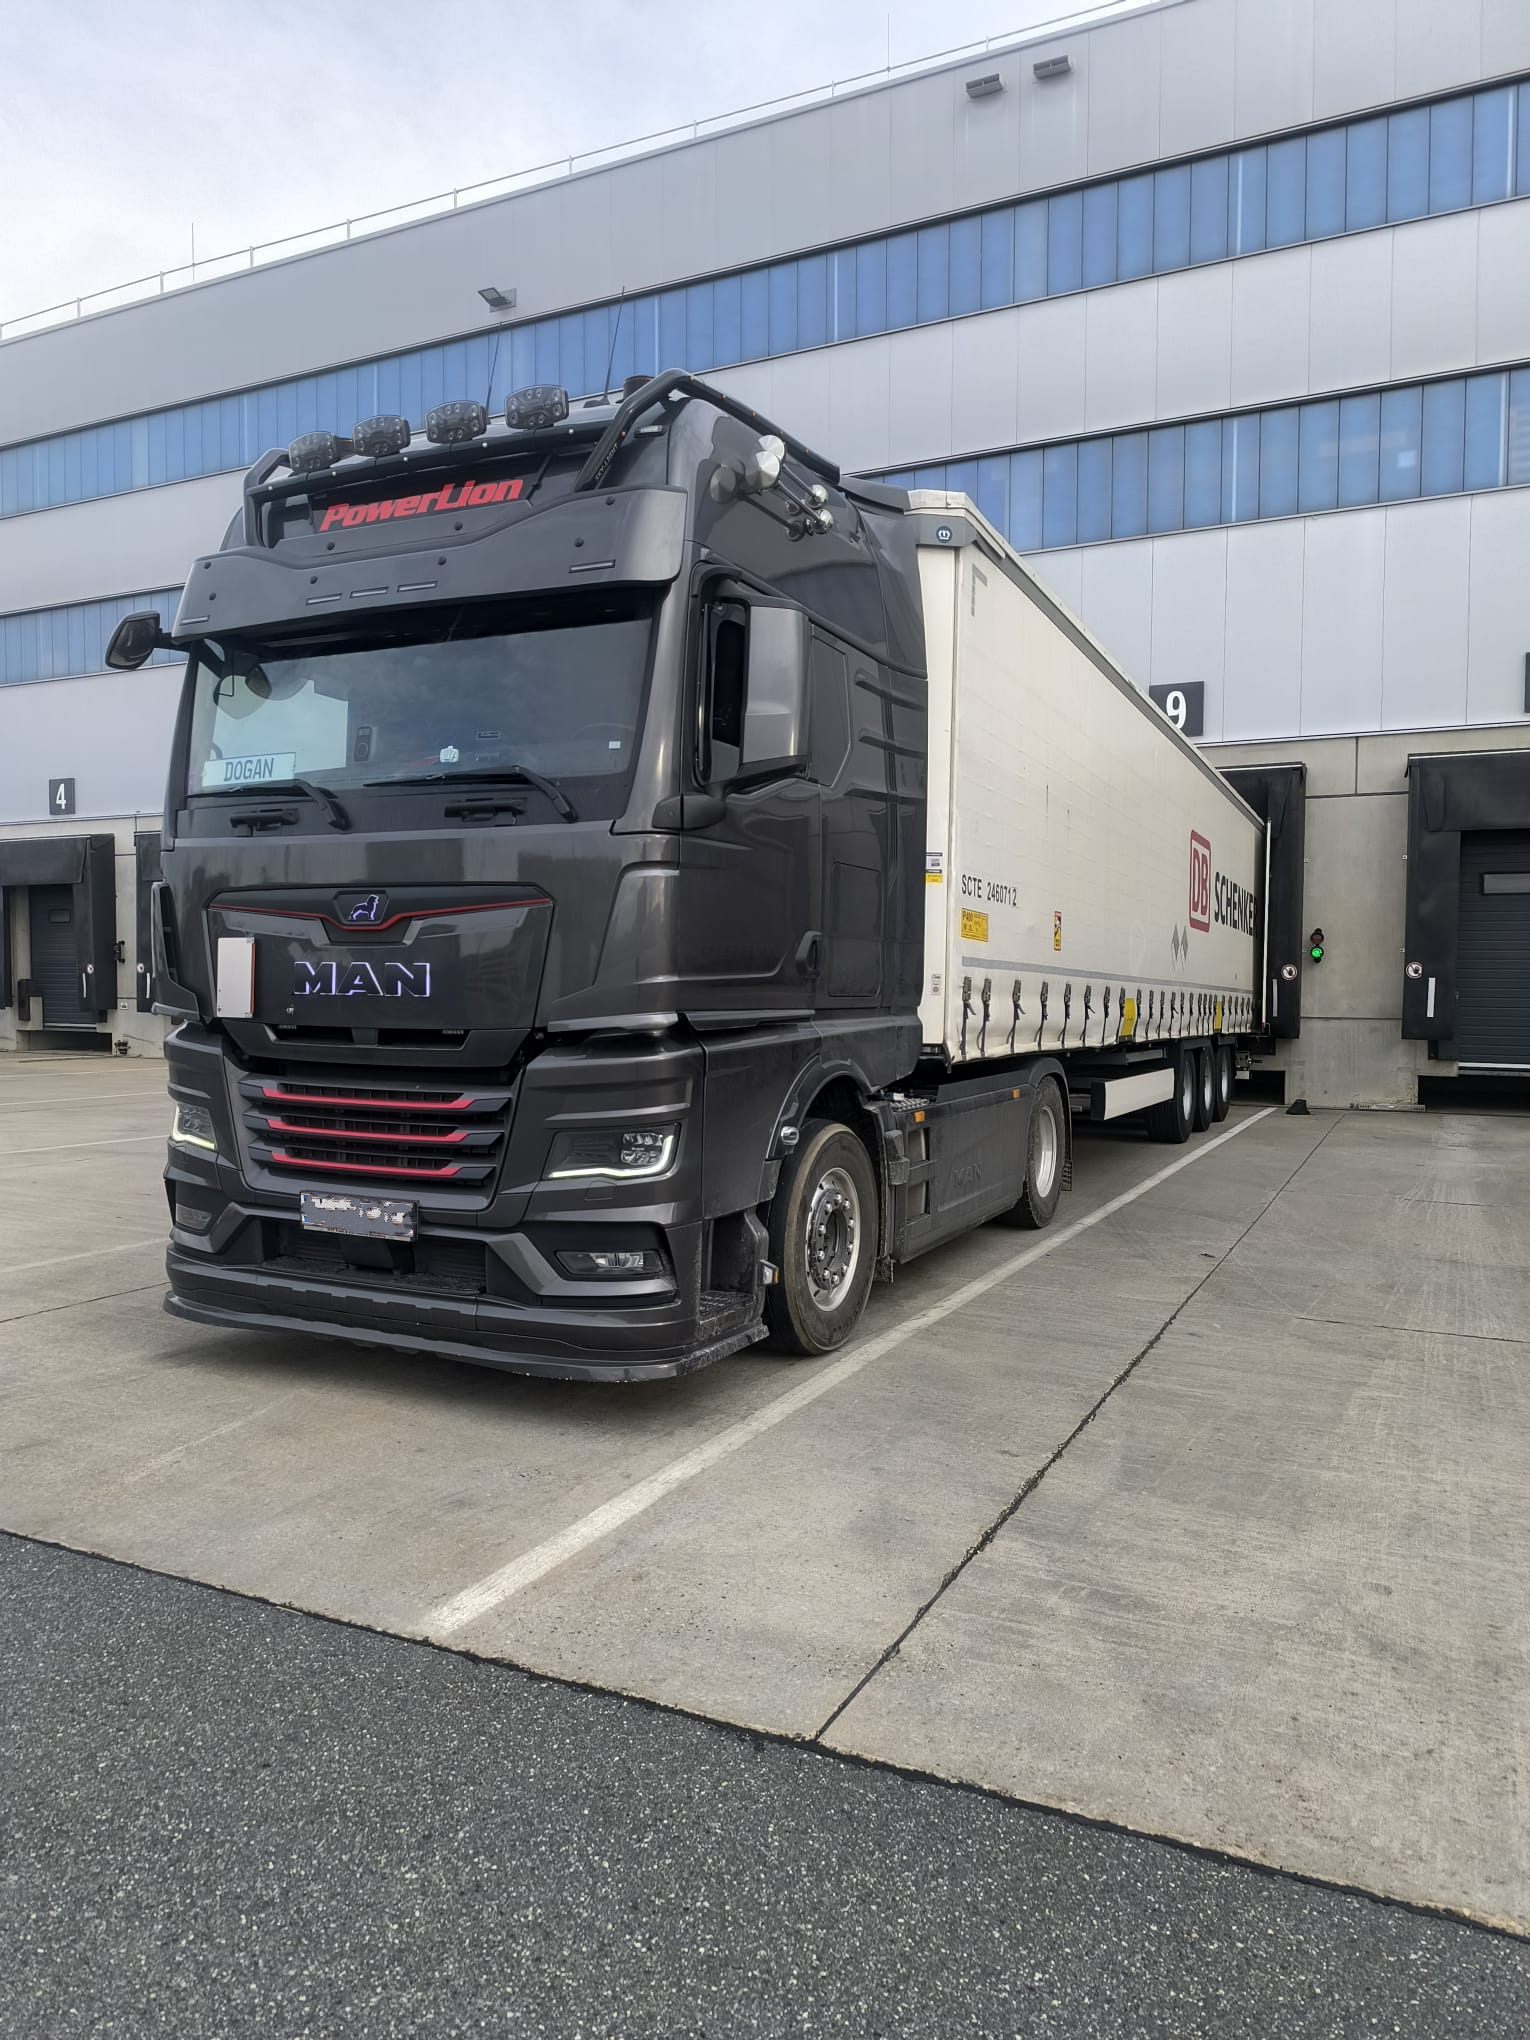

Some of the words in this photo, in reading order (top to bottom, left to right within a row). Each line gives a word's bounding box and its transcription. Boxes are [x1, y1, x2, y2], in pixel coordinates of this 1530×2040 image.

[319, 479, 524, 532] PowerLion
[1166, 690, 1187, 729] 9
[223, 757, 275, 782] DOGAN
[55, 783, 67, 810] 4
[961, 874, 983, 899] SCTE
[987, 881, 1017, 906] 2460712
[1191, 847, 1209, 917] DB
[293, 961, 431, 998] MAN
